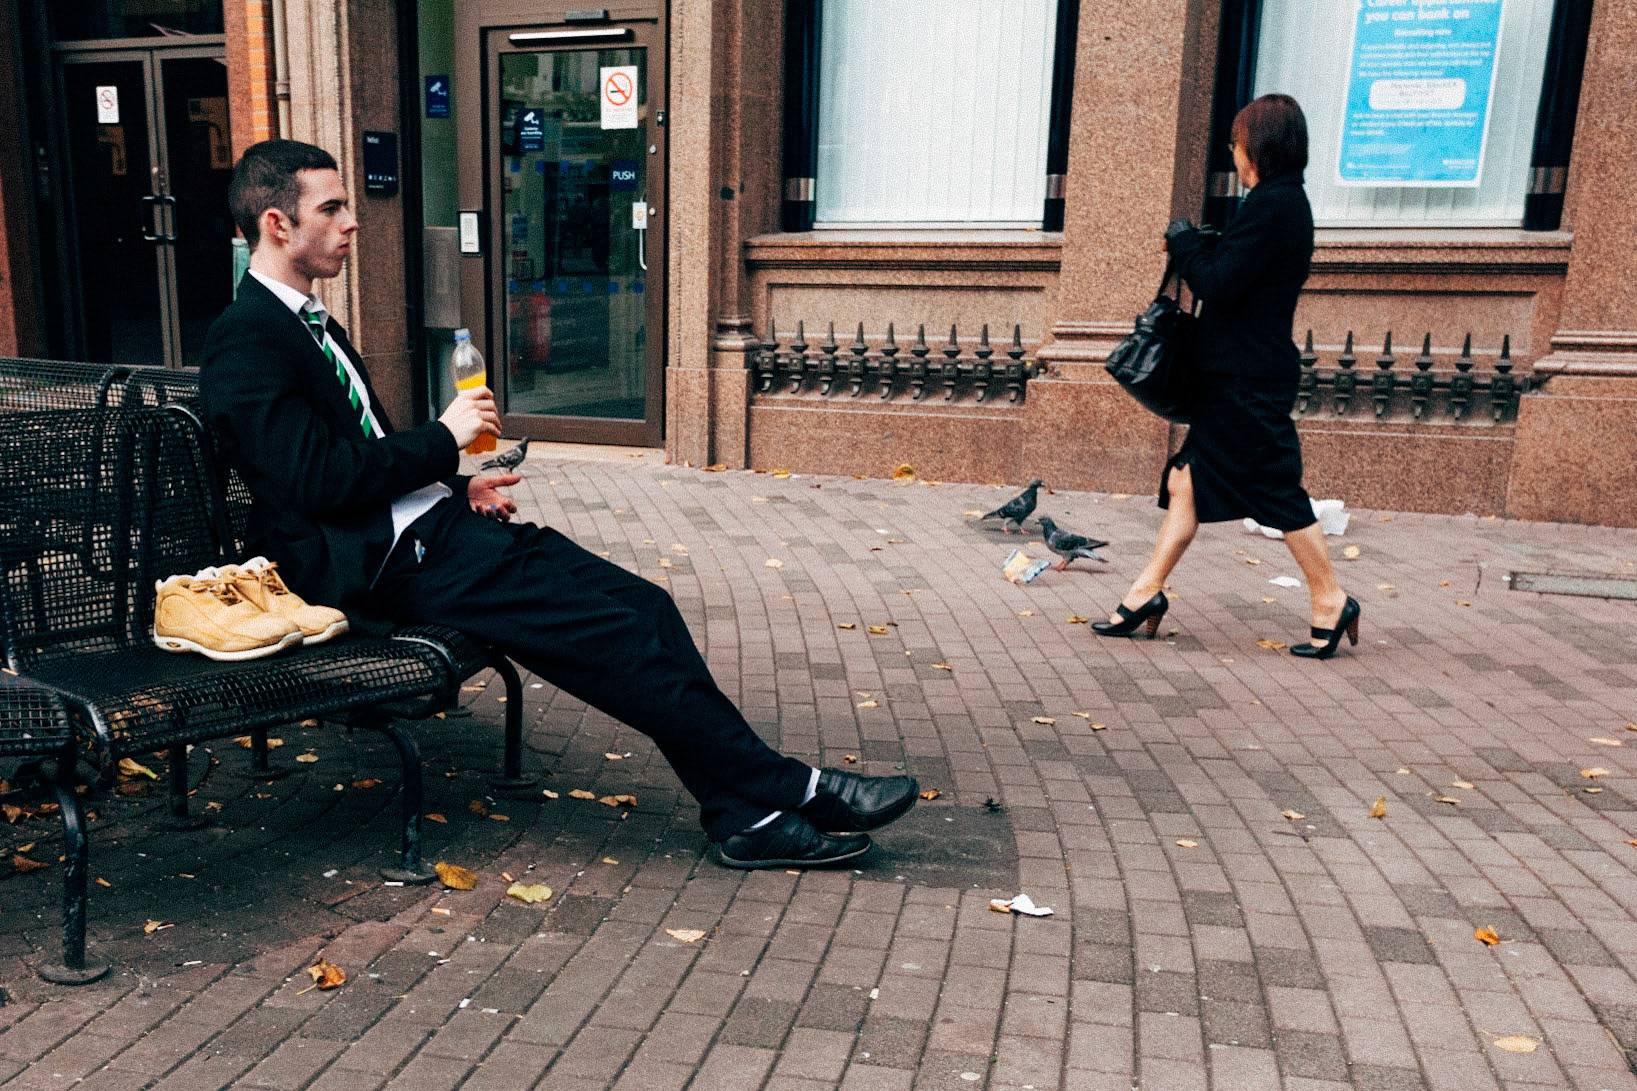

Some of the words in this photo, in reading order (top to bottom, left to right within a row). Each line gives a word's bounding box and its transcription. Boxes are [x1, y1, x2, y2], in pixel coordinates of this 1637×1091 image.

[1365, 12, 1389, 24] you
[1391, 11, 1415, 21] can
[1417, 8, 1450, 20] bank
[1453, 9, 1471, 19] on
[612, 170, 636, 180] PUSH
